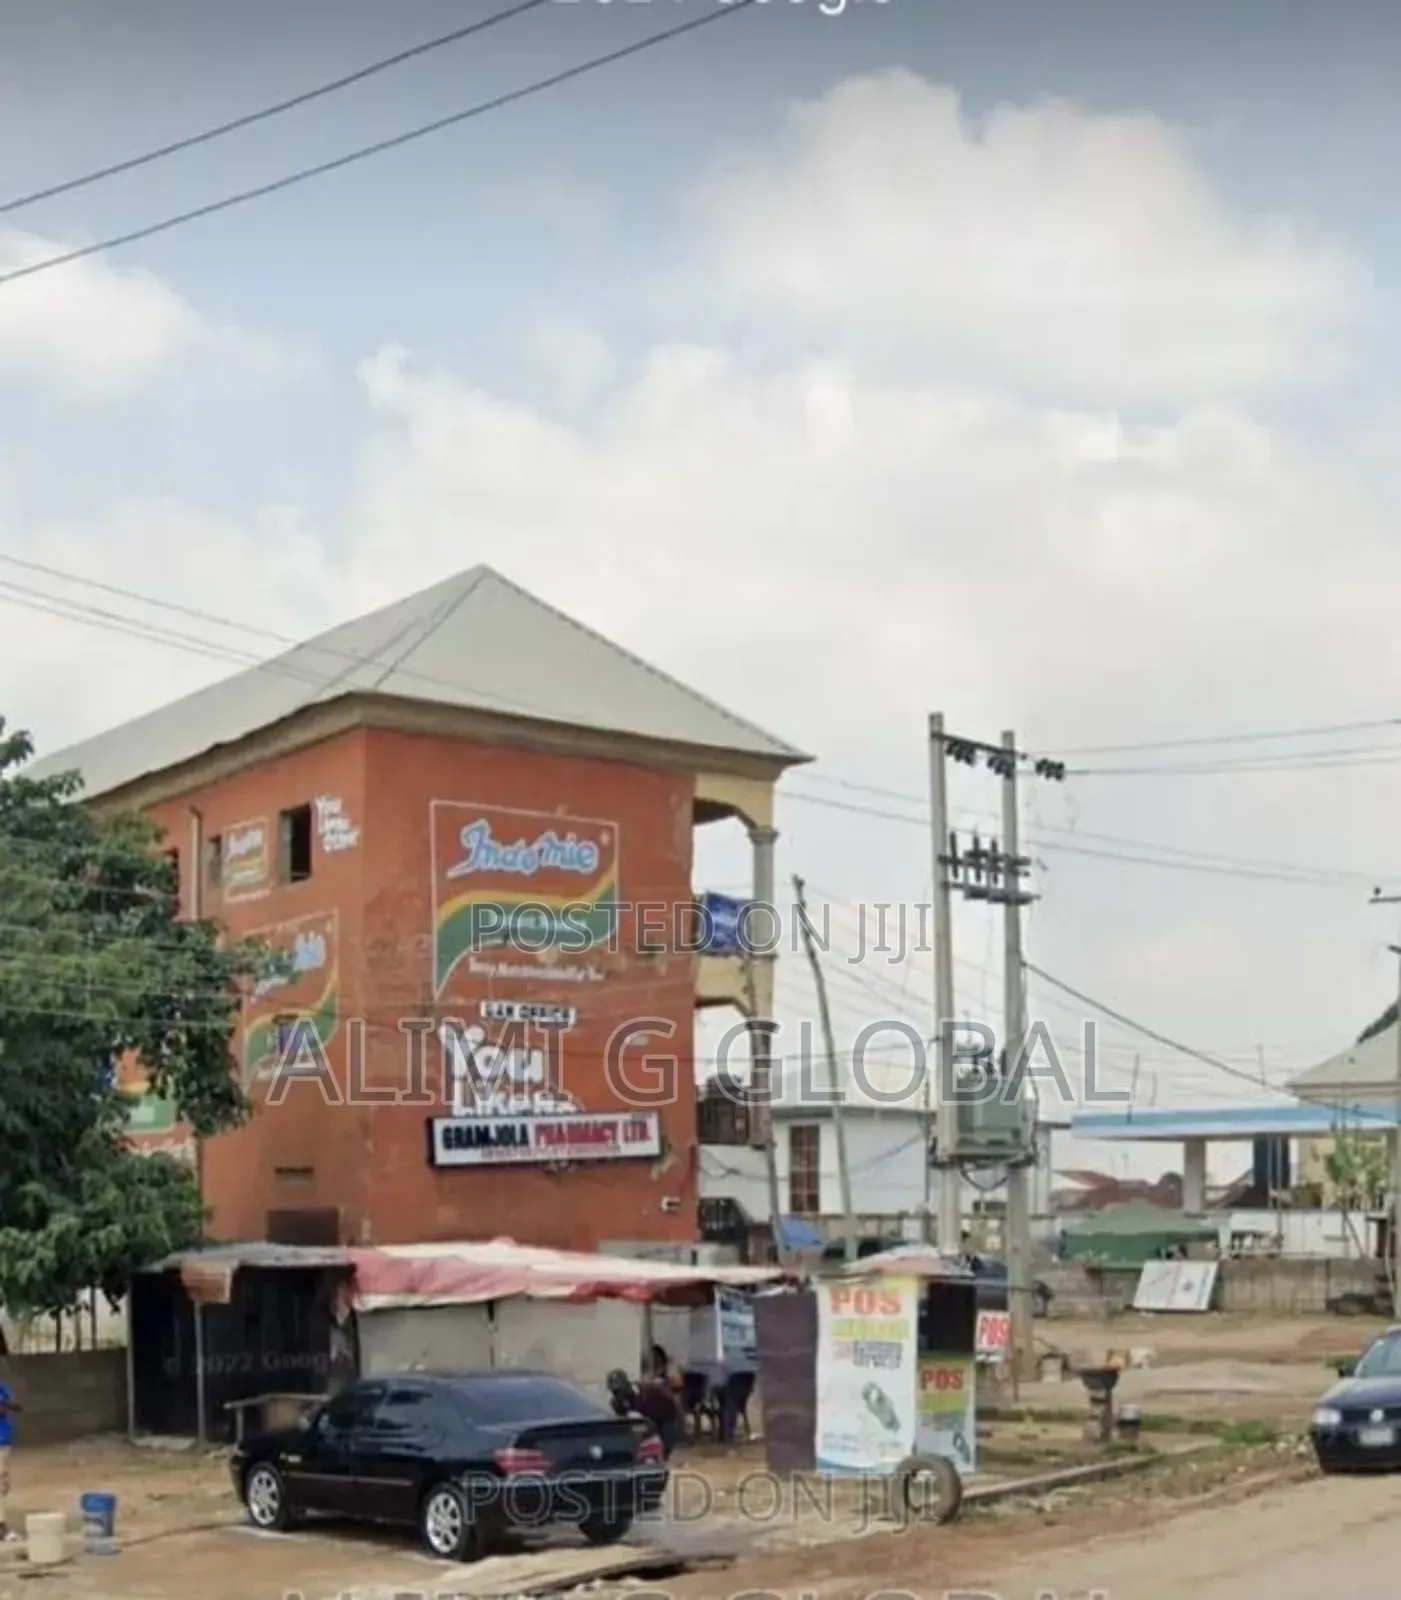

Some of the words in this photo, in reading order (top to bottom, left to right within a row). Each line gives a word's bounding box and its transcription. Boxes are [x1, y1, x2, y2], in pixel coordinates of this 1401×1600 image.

[830, 1286, 902, 1315] POS
[979, 1316, 1010, 1345] POS
[921, 1368, 964, 1391] POS
